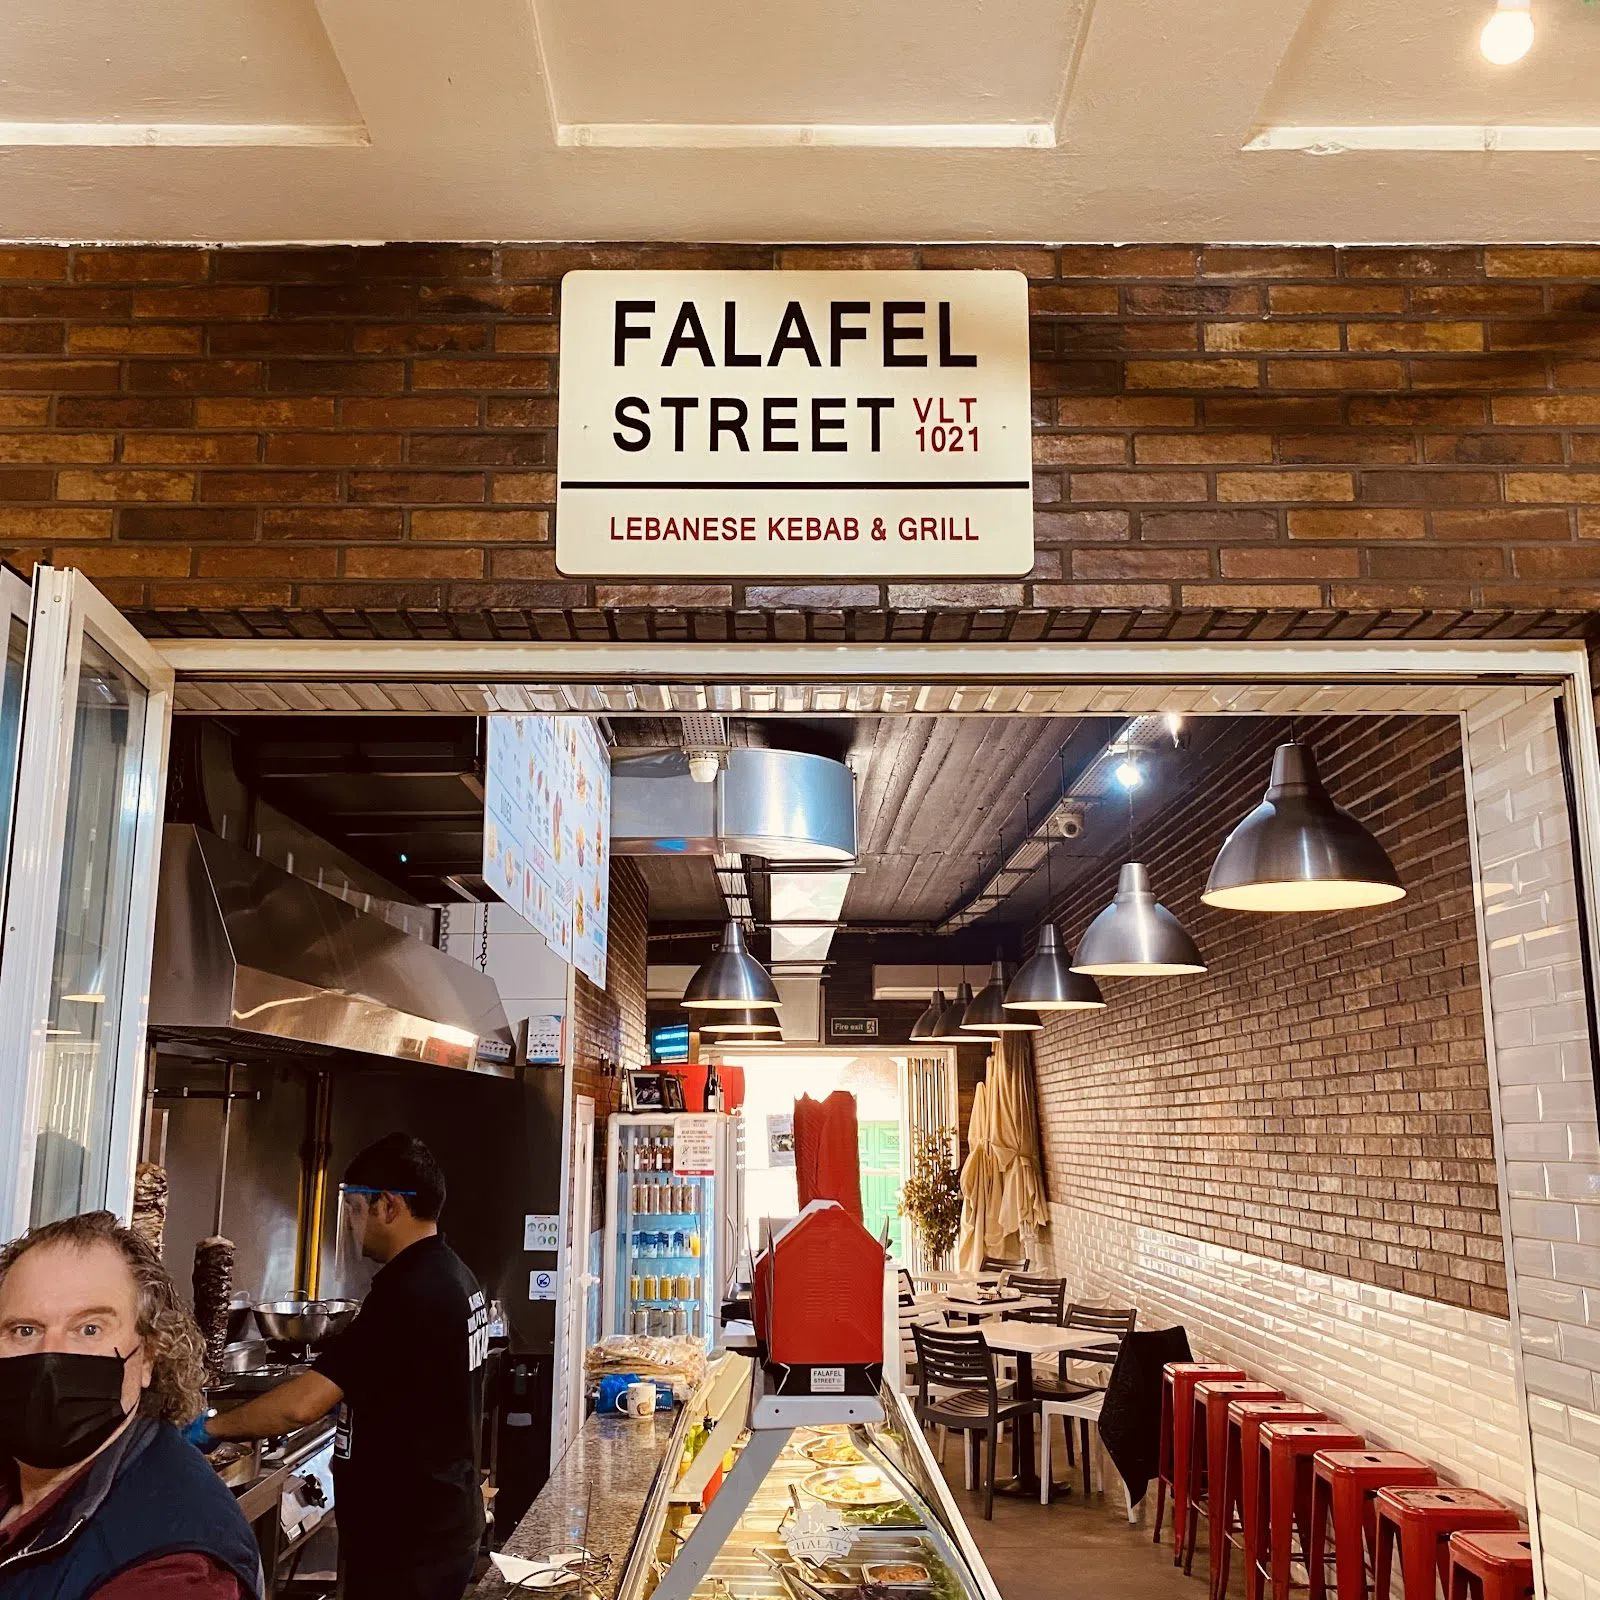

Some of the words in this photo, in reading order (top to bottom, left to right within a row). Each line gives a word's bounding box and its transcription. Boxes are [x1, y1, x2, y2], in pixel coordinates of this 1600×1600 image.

[613, 300, 978, 368] FALAFEL
[912, 397, 978, 424] VLT
[612, 396, 895, 453] STREET
[914, 426, 979, 452] 1021
[609, 516, 757, 541] LEBANESE
[767, 516, 860, 541] KEBAB
[870, 516, 887, 541] &
[897, 516, 979, 541] GRILL
[795, 1539, 843, 1552] HALAL
